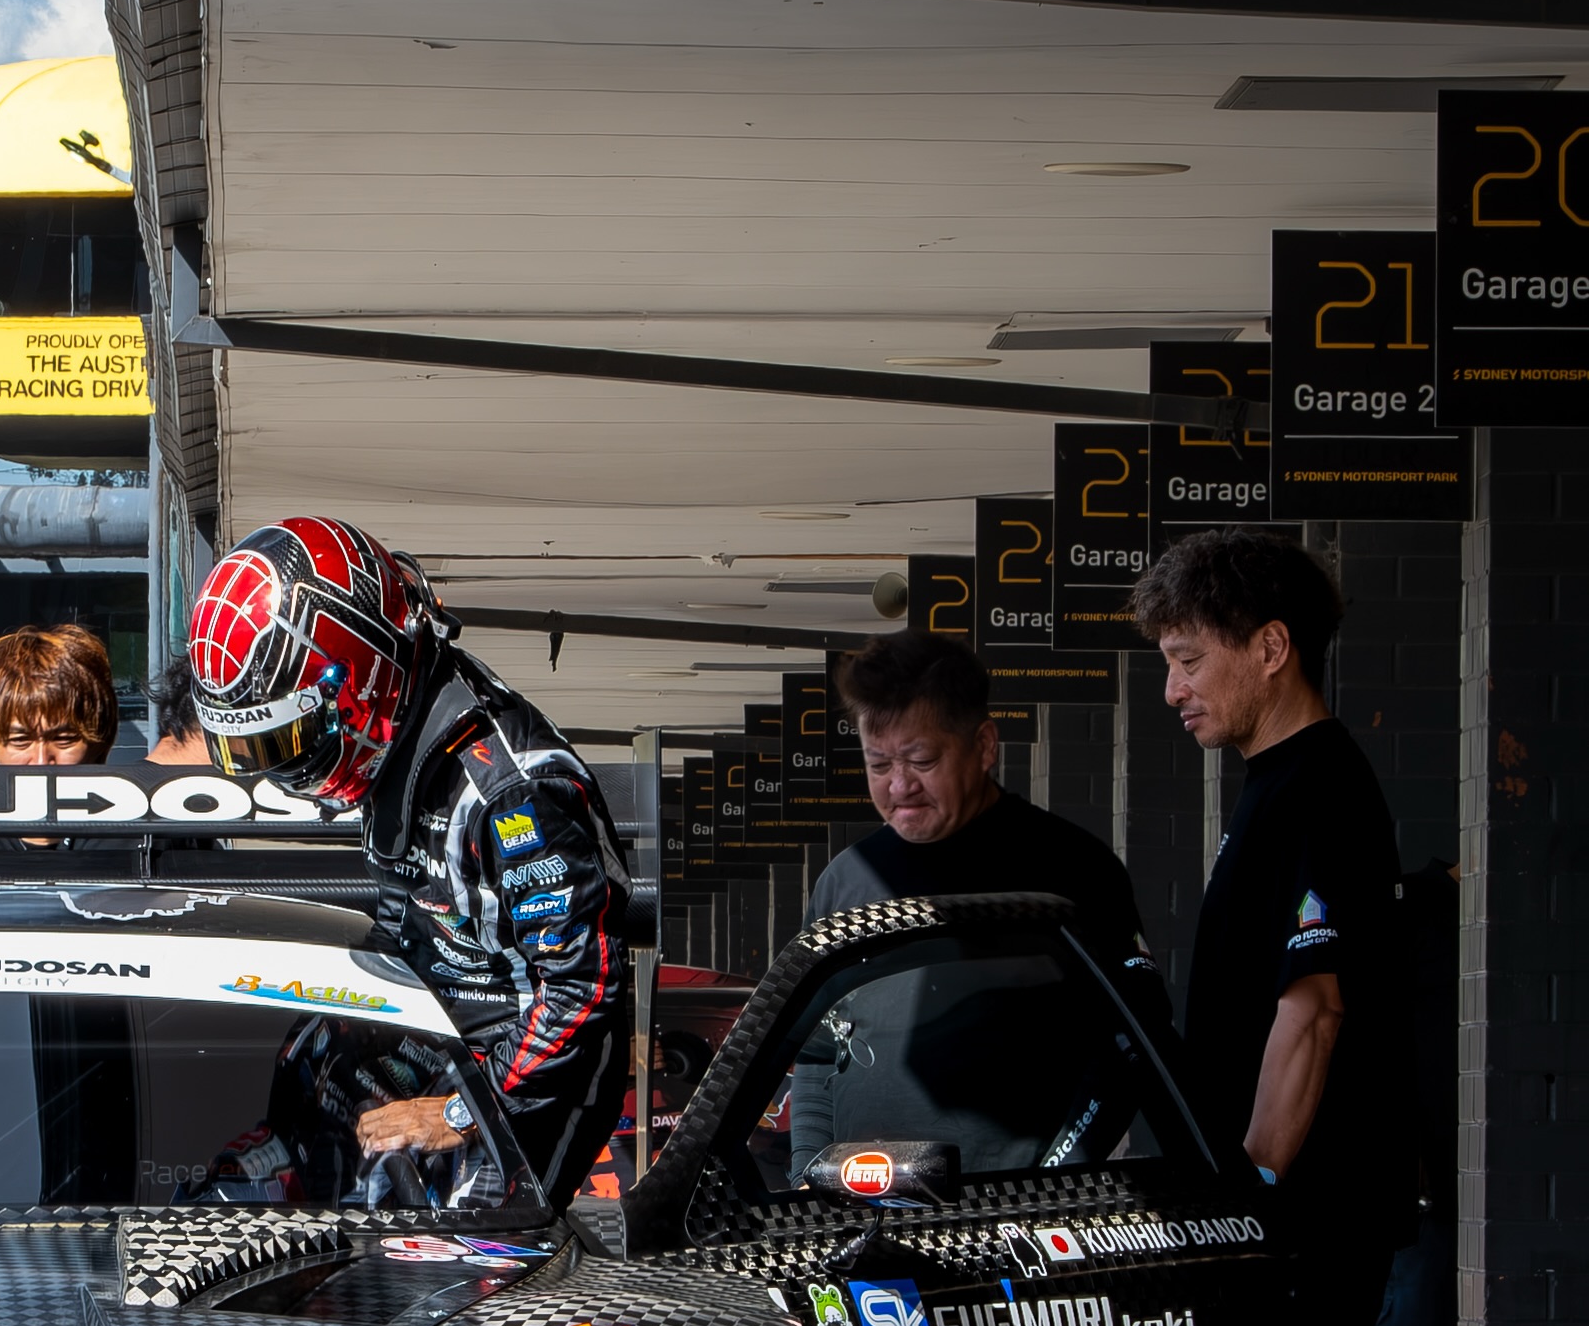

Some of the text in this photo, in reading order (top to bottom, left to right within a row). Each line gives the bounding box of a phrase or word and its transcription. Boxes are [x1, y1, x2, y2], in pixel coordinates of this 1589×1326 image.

[1462, 267, 1589, 308] Garage
[1316, 261, 1429, 350] 21
[26, 334, 103, 349] PROUDLY
[26, 355, 72, 373] THE
[1464, 369, 1589, 381] SYDNEY MOTORSP
[93, 379, 148, 398] DRIV
[1294, 384, 1407, 419] Garage
[1082, 449, 1149, 517] 2
[1293, 471, 1458, 483] SYDNEY MOTORSPORT PARK
[1167, 477, 1267, 507] Garage
[998, 521, 1053, 583] 2
[1070, 544, 1149, 572] Garag
[502, 830, 539, 849] GEAR
[519, 900, 561, 914] READY
[16, 977, 70, 988] CITY
[1079, 1216, 1265, 1254] KUNIHIKO BANDO
